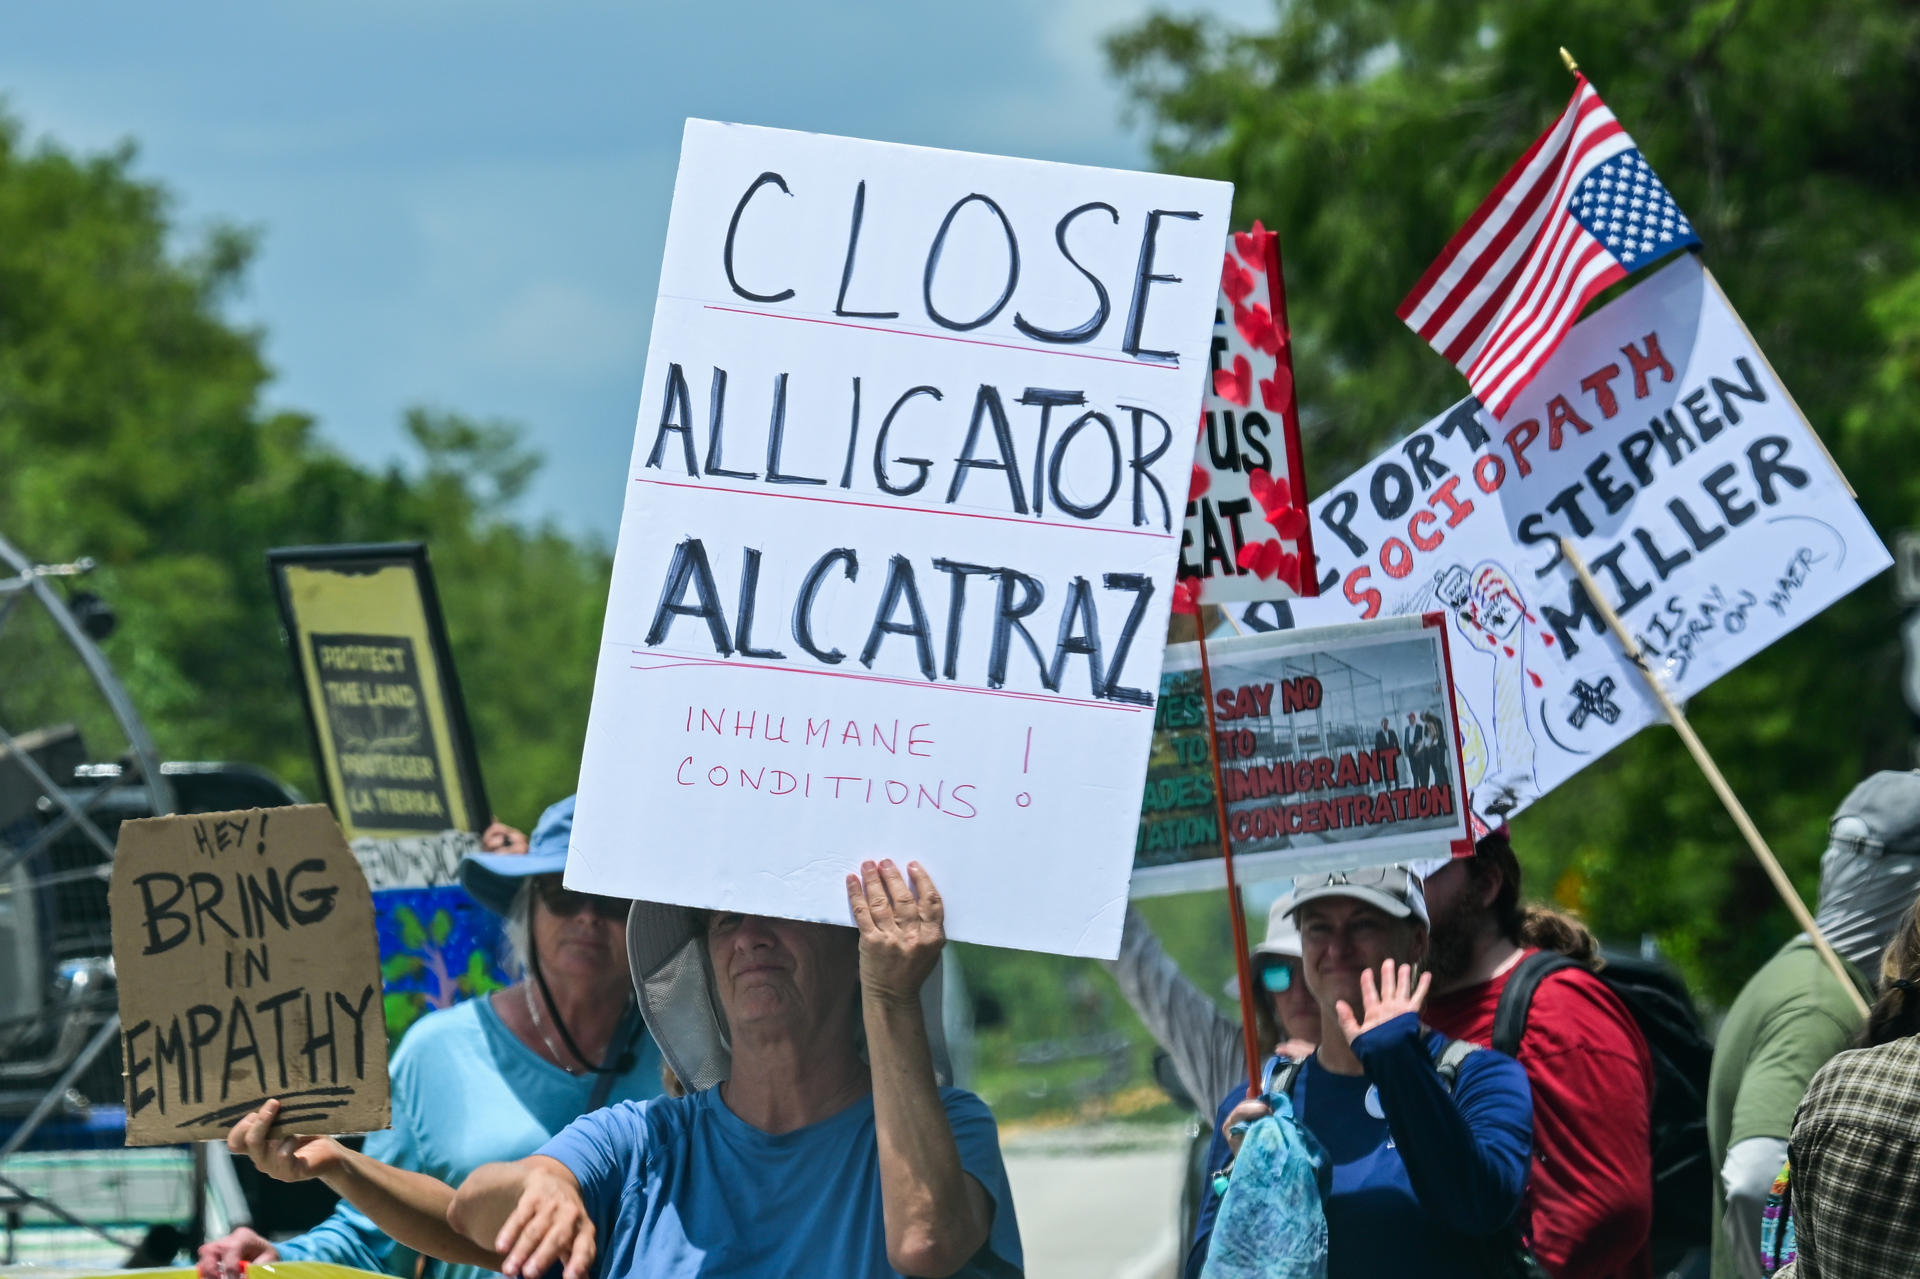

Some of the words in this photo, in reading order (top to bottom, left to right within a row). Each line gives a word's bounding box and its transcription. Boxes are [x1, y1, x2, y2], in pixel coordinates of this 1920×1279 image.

[723, 171, 1203, 364] CLOSE
[645, 362, 1173, 533] ALLIGATOR
[1343, 332, 1675, 620] SOCIOPATH
[1517, 356, 1769, 579] STEPHEN
[1540, 435, 1811, 661] MILLER
[645, 535, 1155, 706] ALCATRAZ
[1667, 584, 1728, 682] SPRAY
[1723, 589, 1757, 634] ON
[319, 645, 405, 672] PROTECT
[325, 681, 363, 706] THE
[364, 682, 417, 707] LAND
[1216, 682, 1274, 722] SAY
[1281, 676, 1323, 713] NO
[685, 706, 936, 757] INHUMANE
[1170, 735, 1207, 766] TO
[1220, 729, 1256, 759] TO
[348, 788, 375, 813] LA
[374, 788, 444, 816] TIERRA
[676, 756, 977, 818] CONDITIONS
[1225, 748, 1399, 803] IMMIGRANT
[1231, 784, 1451, 841] CONCENTRATION
[133, 859, 339, 955] BRING
[225, 943, 270, 988] IN
[125, 984, 374, 1118] EMPATHY
